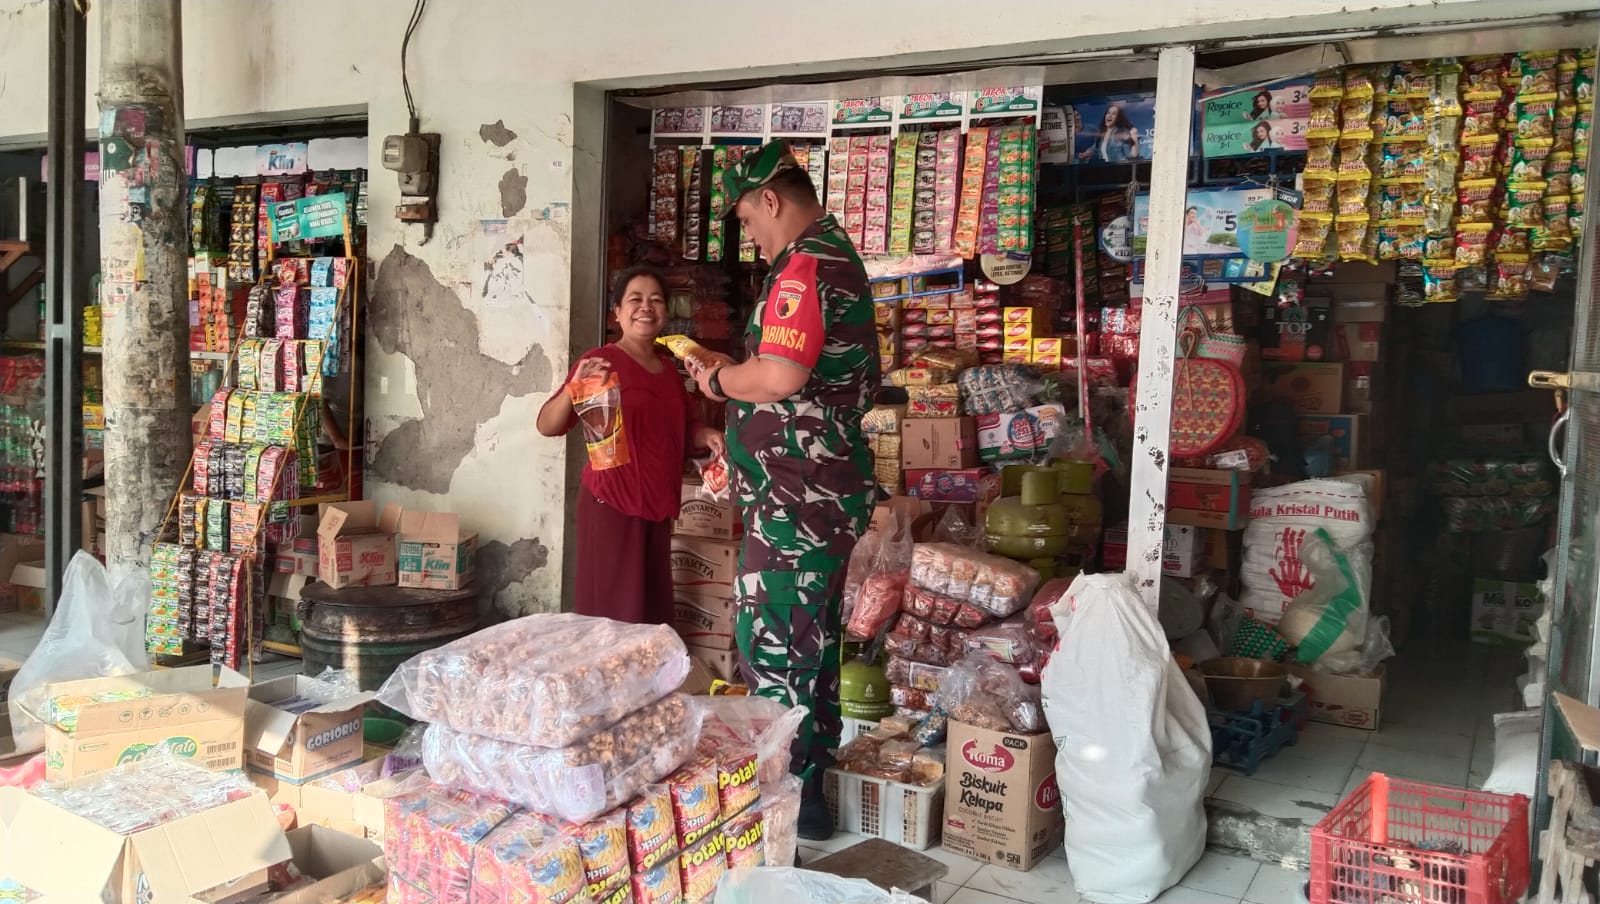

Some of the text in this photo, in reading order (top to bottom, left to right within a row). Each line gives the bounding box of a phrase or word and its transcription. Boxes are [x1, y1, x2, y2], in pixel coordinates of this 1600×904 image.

[1207, 101, 1243, 112] Rejoice
[1207, 131, 1242, 143] Rejoice
[268, 154, 295, 171] Klin
[1224, 214, 1237, 231] 5
[1275, 322, 1313, 335] TOP
[762, 325, 806, 352] ABINSA
[1276, 504, 1320, 516] Kristal
[1324, 505, 1359, 521] Putih
[671, 557, 715, 579] NYAKITA
[306, 718, 361, 752] GORIORIO
[1004, 739, 1026, 749] PACK
[959, 771, 1008, 797] Biskuit
[959, 788, 1004, 814] Kelapa
